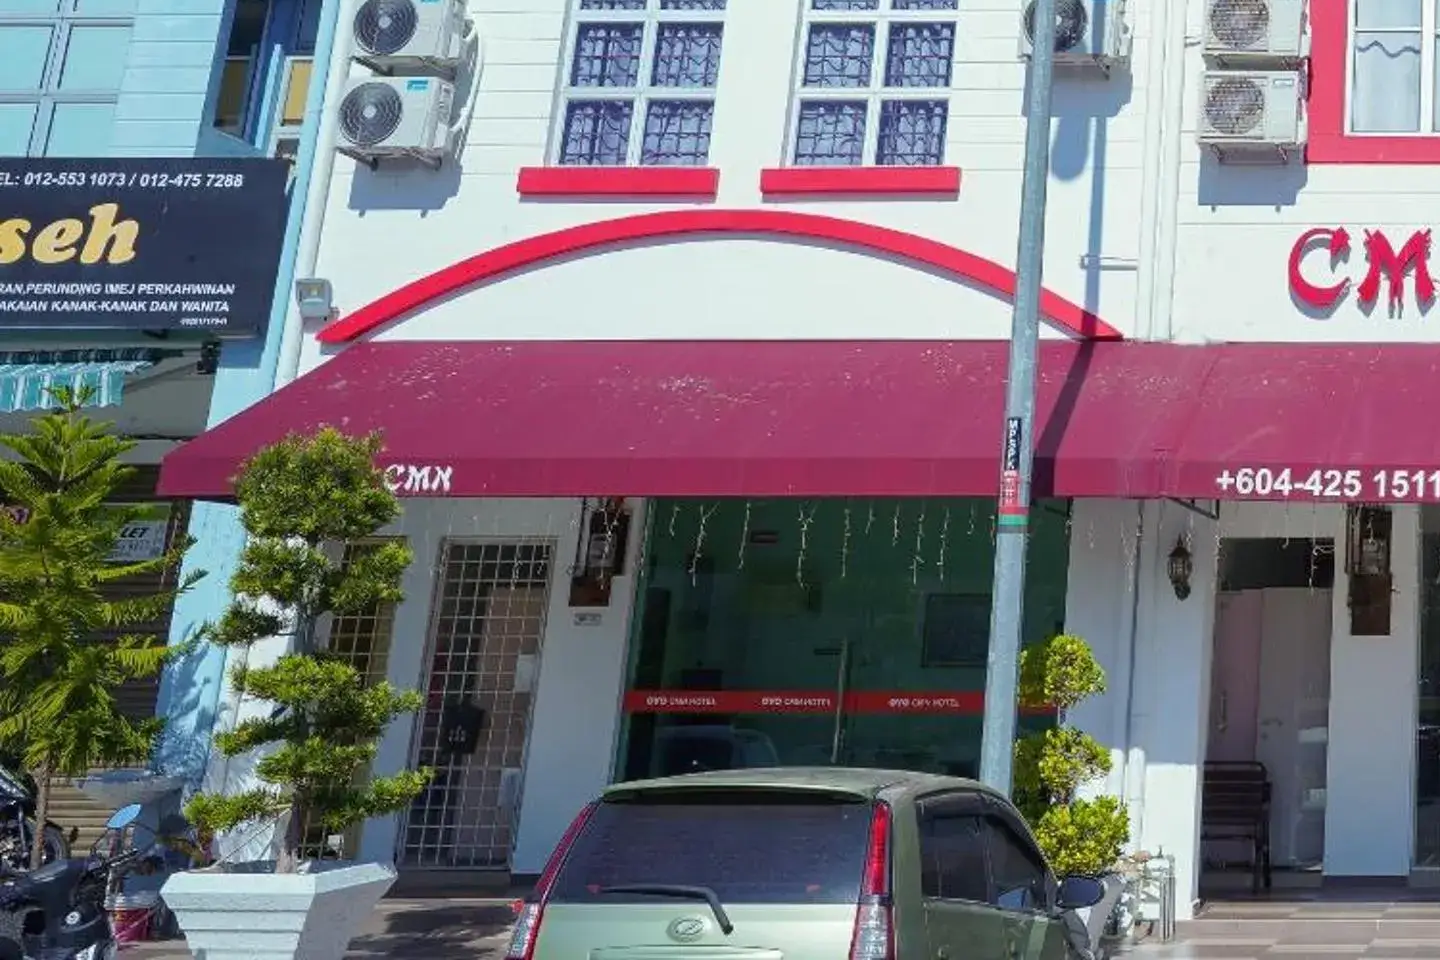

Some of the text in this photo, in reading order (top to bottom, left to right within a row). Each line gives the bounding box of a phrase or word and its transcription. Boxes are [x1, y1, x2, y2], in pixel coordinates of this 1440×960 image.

[24, 172, 86, 186] 012-553
[90, 172, 126, 186] 1073
[140, 173, 202, 187] 012-475
[206, 174, 243, 187] 7288
[0, 203, 139, 264] seh
[105, 283, 135, 295] IMEJ
[138, 283, 235, 295] PERKAHWINAN
[51, 301, 147, 312] KANAK-KANAK
[149, 301, 178, 312] DAN
[181, 301, 229, 312] WANITA
[384, 464, 453, 492] CMN
[1216, 468, 1362, 497] +604-425
[120, 526, 149, 538] LET
